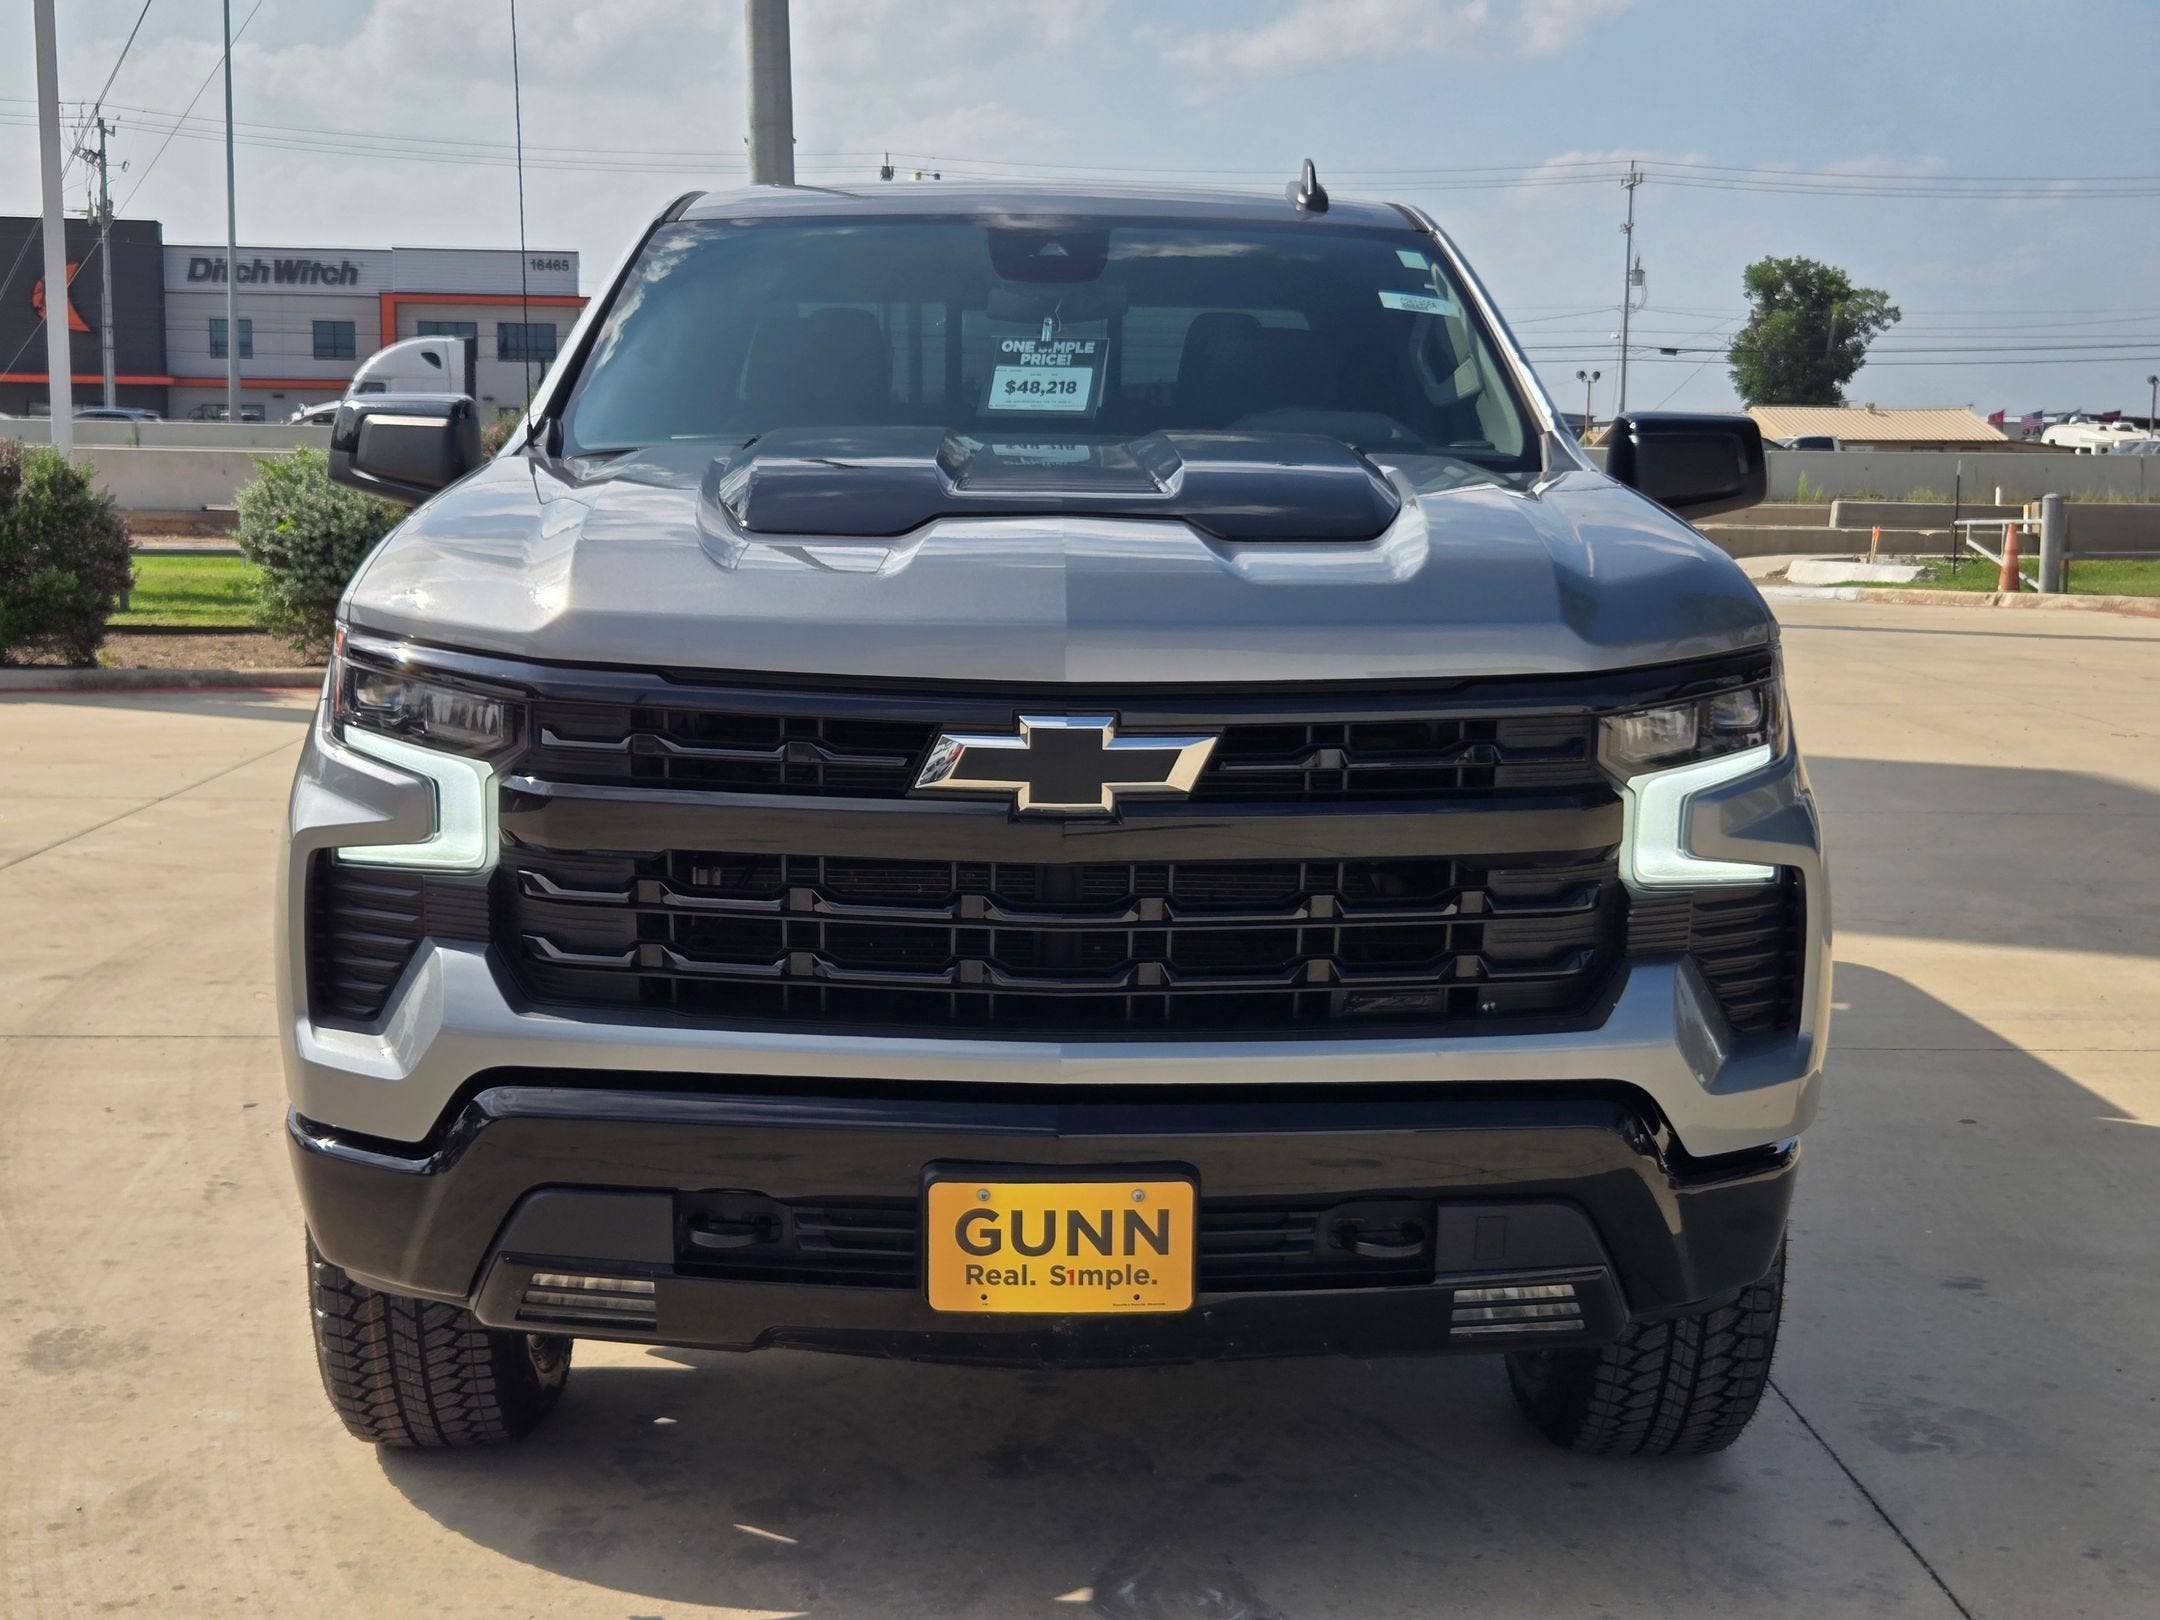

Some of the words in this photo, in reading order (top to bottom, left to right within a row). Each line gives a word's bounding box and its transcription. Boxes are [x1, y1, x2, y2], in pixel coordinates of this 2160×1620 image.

[273, 259, 358, 285] Witch
[530, 259, 570, 271] 16465
[1001, 340, 1036, 353] ONE
[1020, 353, 1072, 366] PRICE!
[1004, 379, 1077, 397] $48,218
[955, 1208, 1169, 1256] GUNN
[966, 1264, 1036, 1285] Real.
[1050, 1264, 1157, 1289] S1mple.
